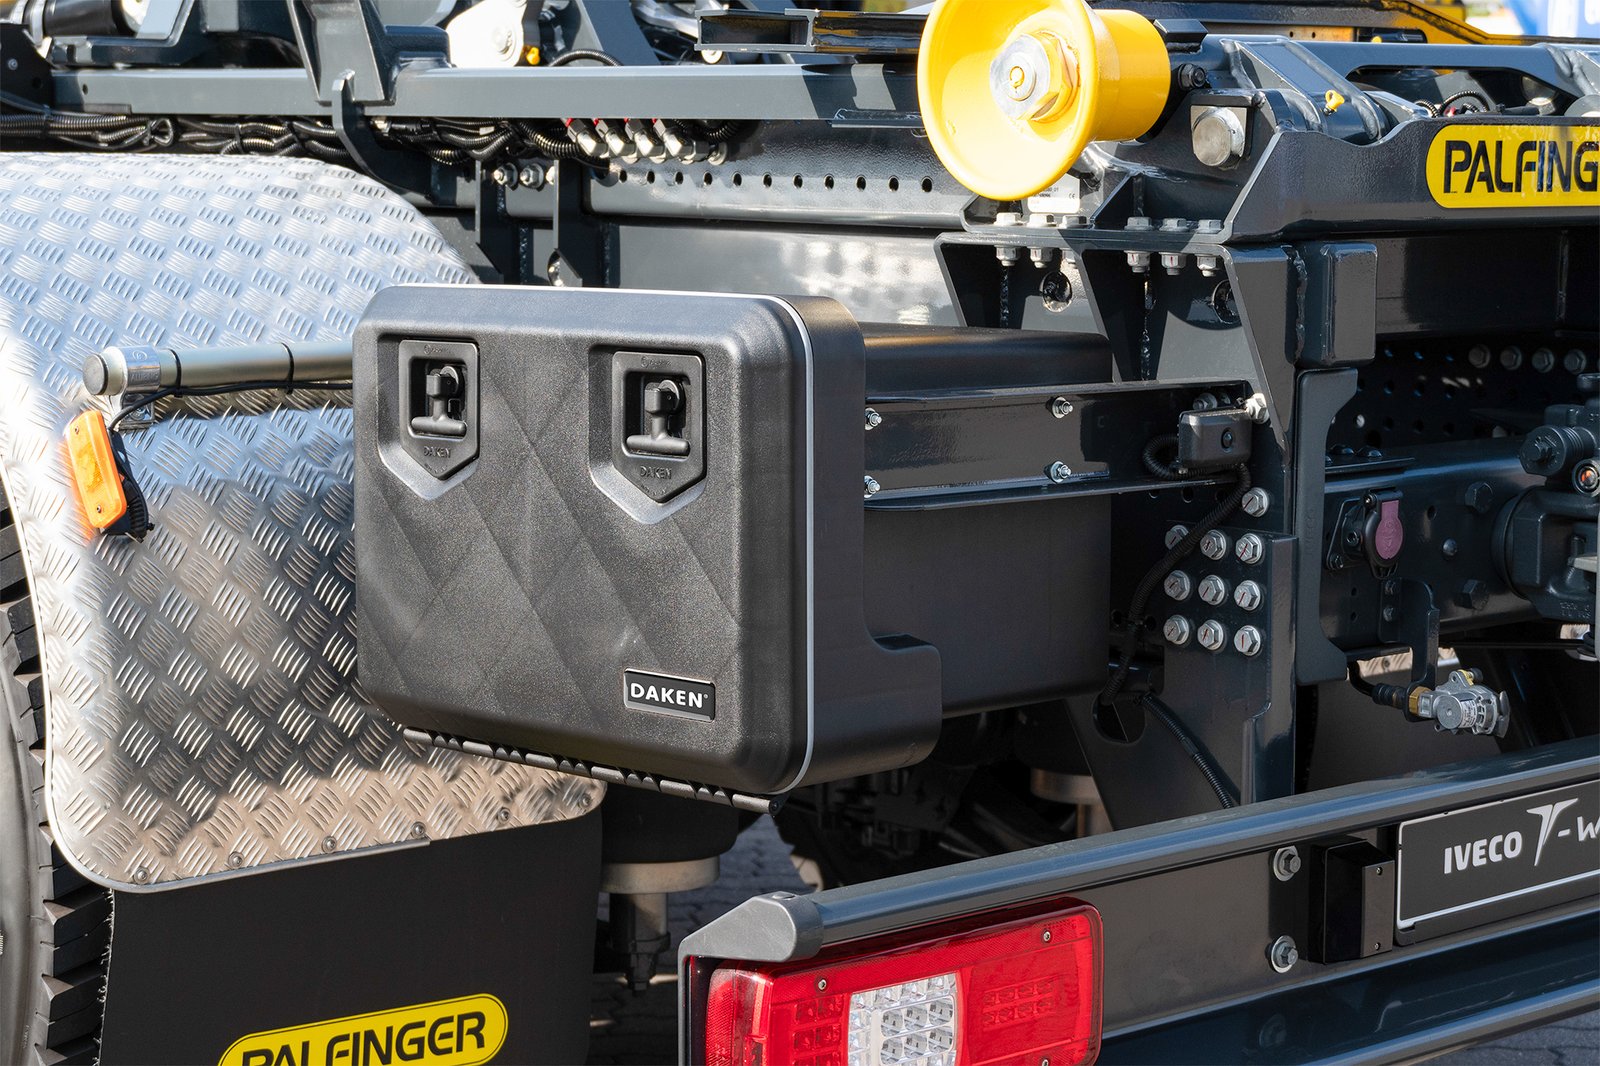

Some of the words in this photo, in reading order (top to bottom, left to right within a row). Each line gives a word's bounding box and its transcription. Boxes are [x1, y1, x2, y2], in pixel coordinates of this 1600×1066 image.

[1443, 140, 1599, 193] PALFING
[423, 445, 451, 458] DAKEN
[640, 465, 672, 479] DAKEN
[1444, 831, 1522, 874] IVECO
